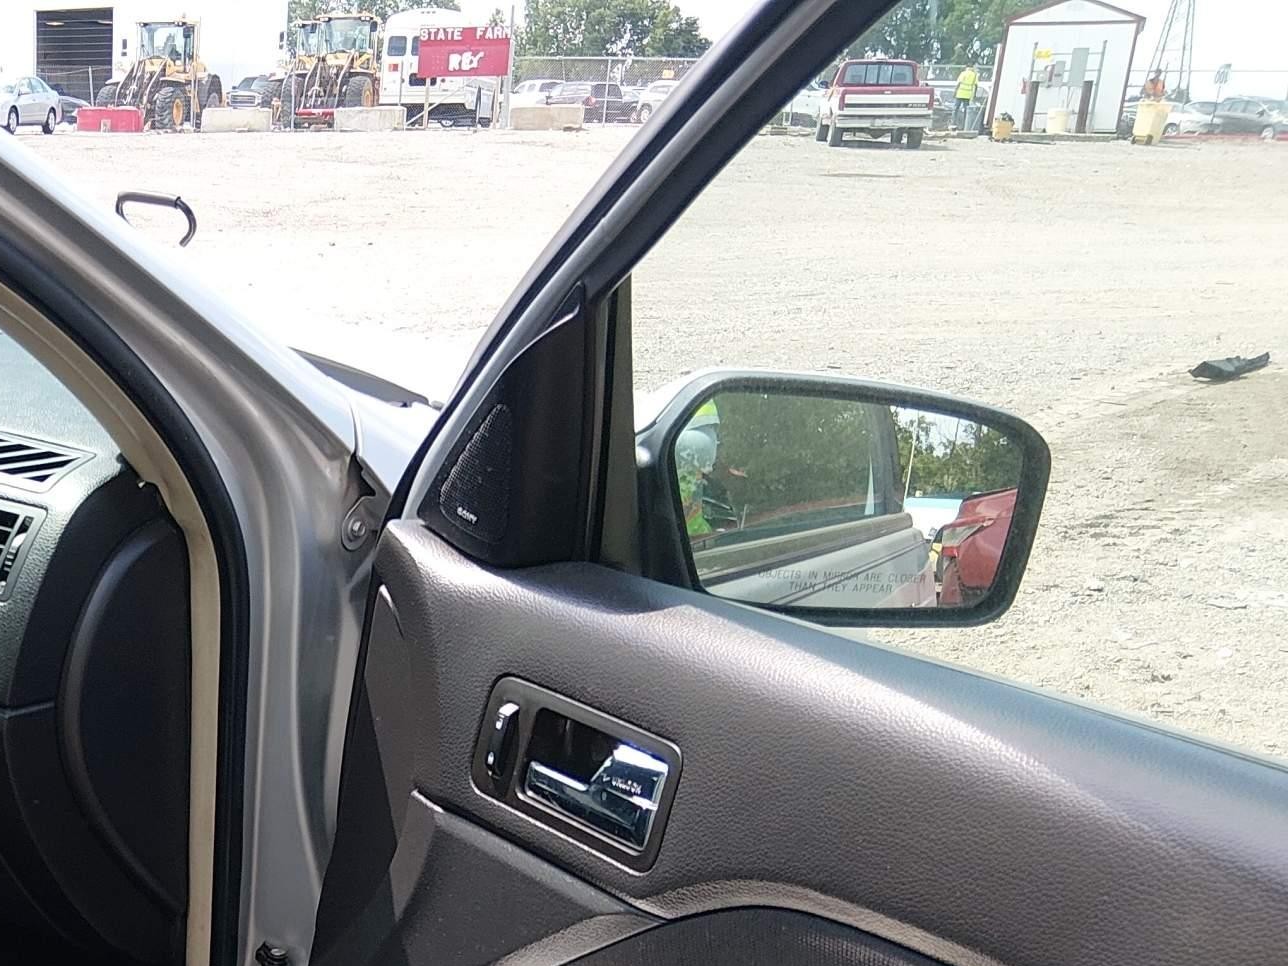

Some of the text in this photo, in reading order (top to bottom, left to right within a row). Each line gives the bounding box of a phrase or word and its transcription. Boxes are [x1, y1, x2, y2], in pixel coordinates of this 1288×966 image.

[420, 27, 512, 41] STATE FARM
[759, 569, 801, 579] OBJECTS
[808, 571, 818, 579] IN
[864, 573, 882, 582] ARE
[888, 573, 926, 584] CLOSER
[789, 582, 893, 593] THAN THEY APPEAR
